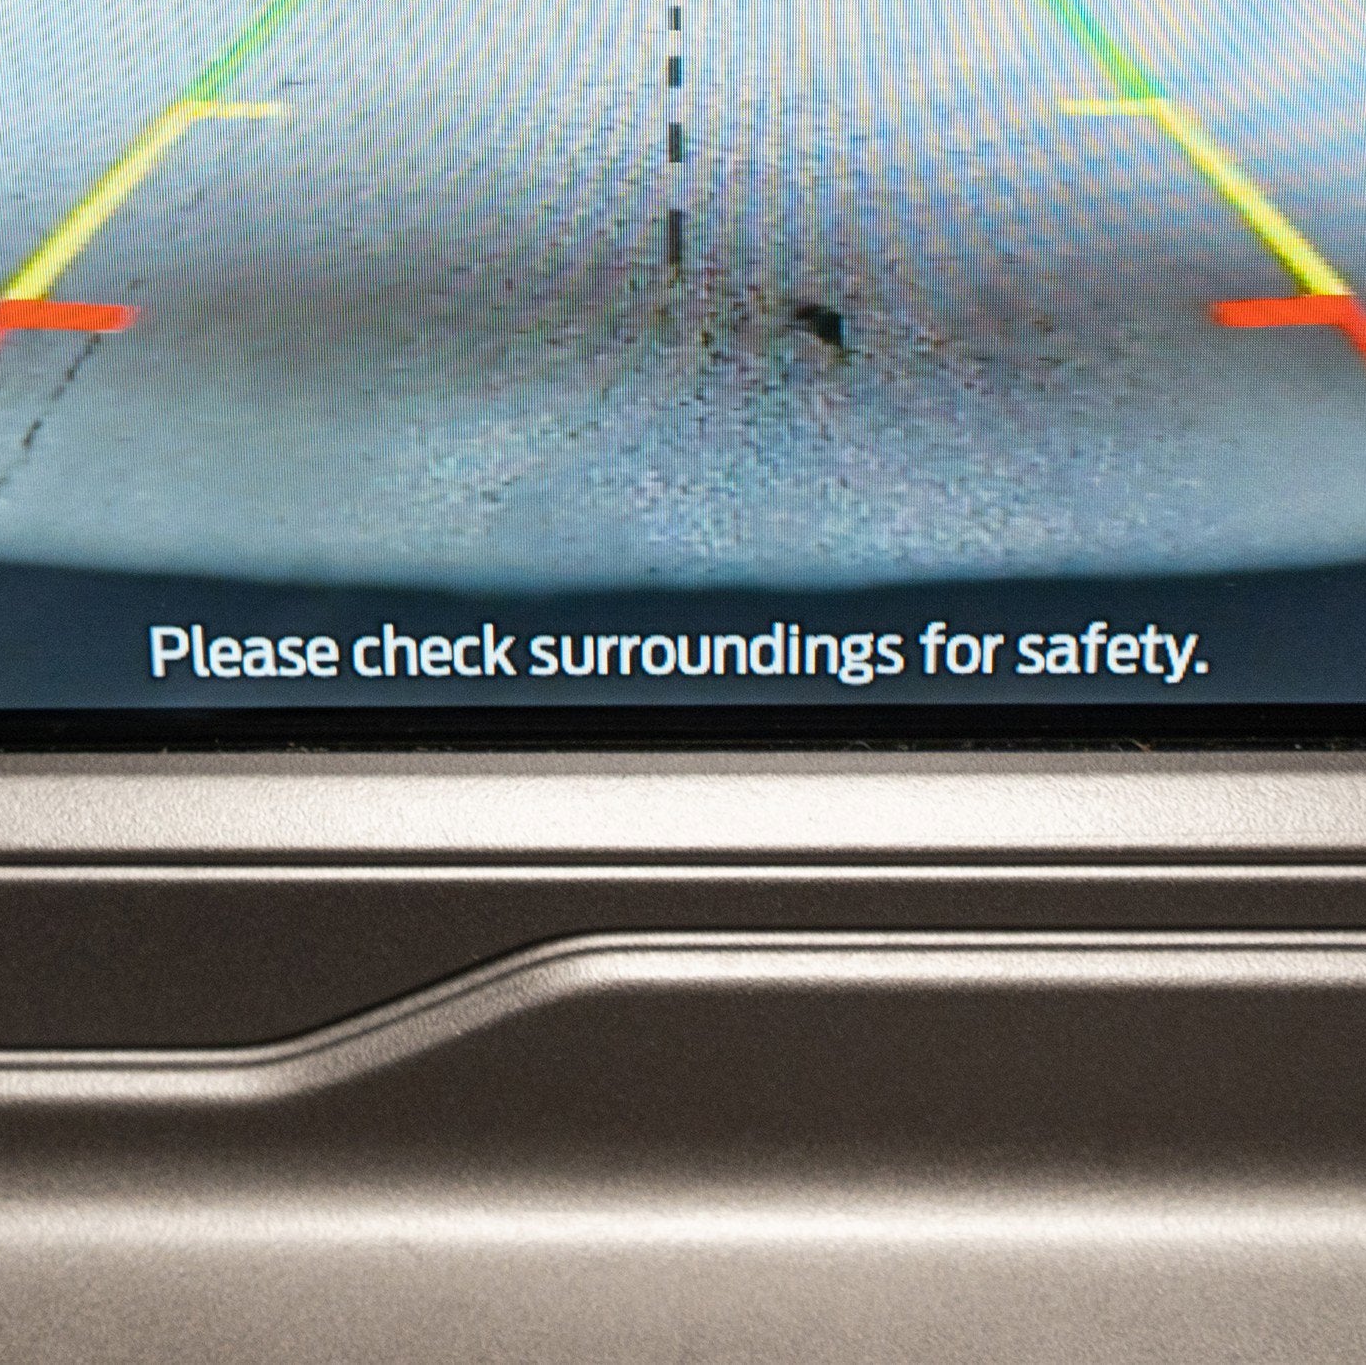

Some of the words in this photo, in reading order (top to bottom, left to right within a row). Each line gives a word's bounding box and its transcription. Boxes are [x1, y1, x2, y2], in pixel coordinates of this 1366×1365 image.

[149, 622, 341, 679] Please
[352, 621, 518, 678] check
[529, 620, 905, 686] surroundings
[918, 619, 1005, 675] for
[1016, 619, 1209, 685] safety.
